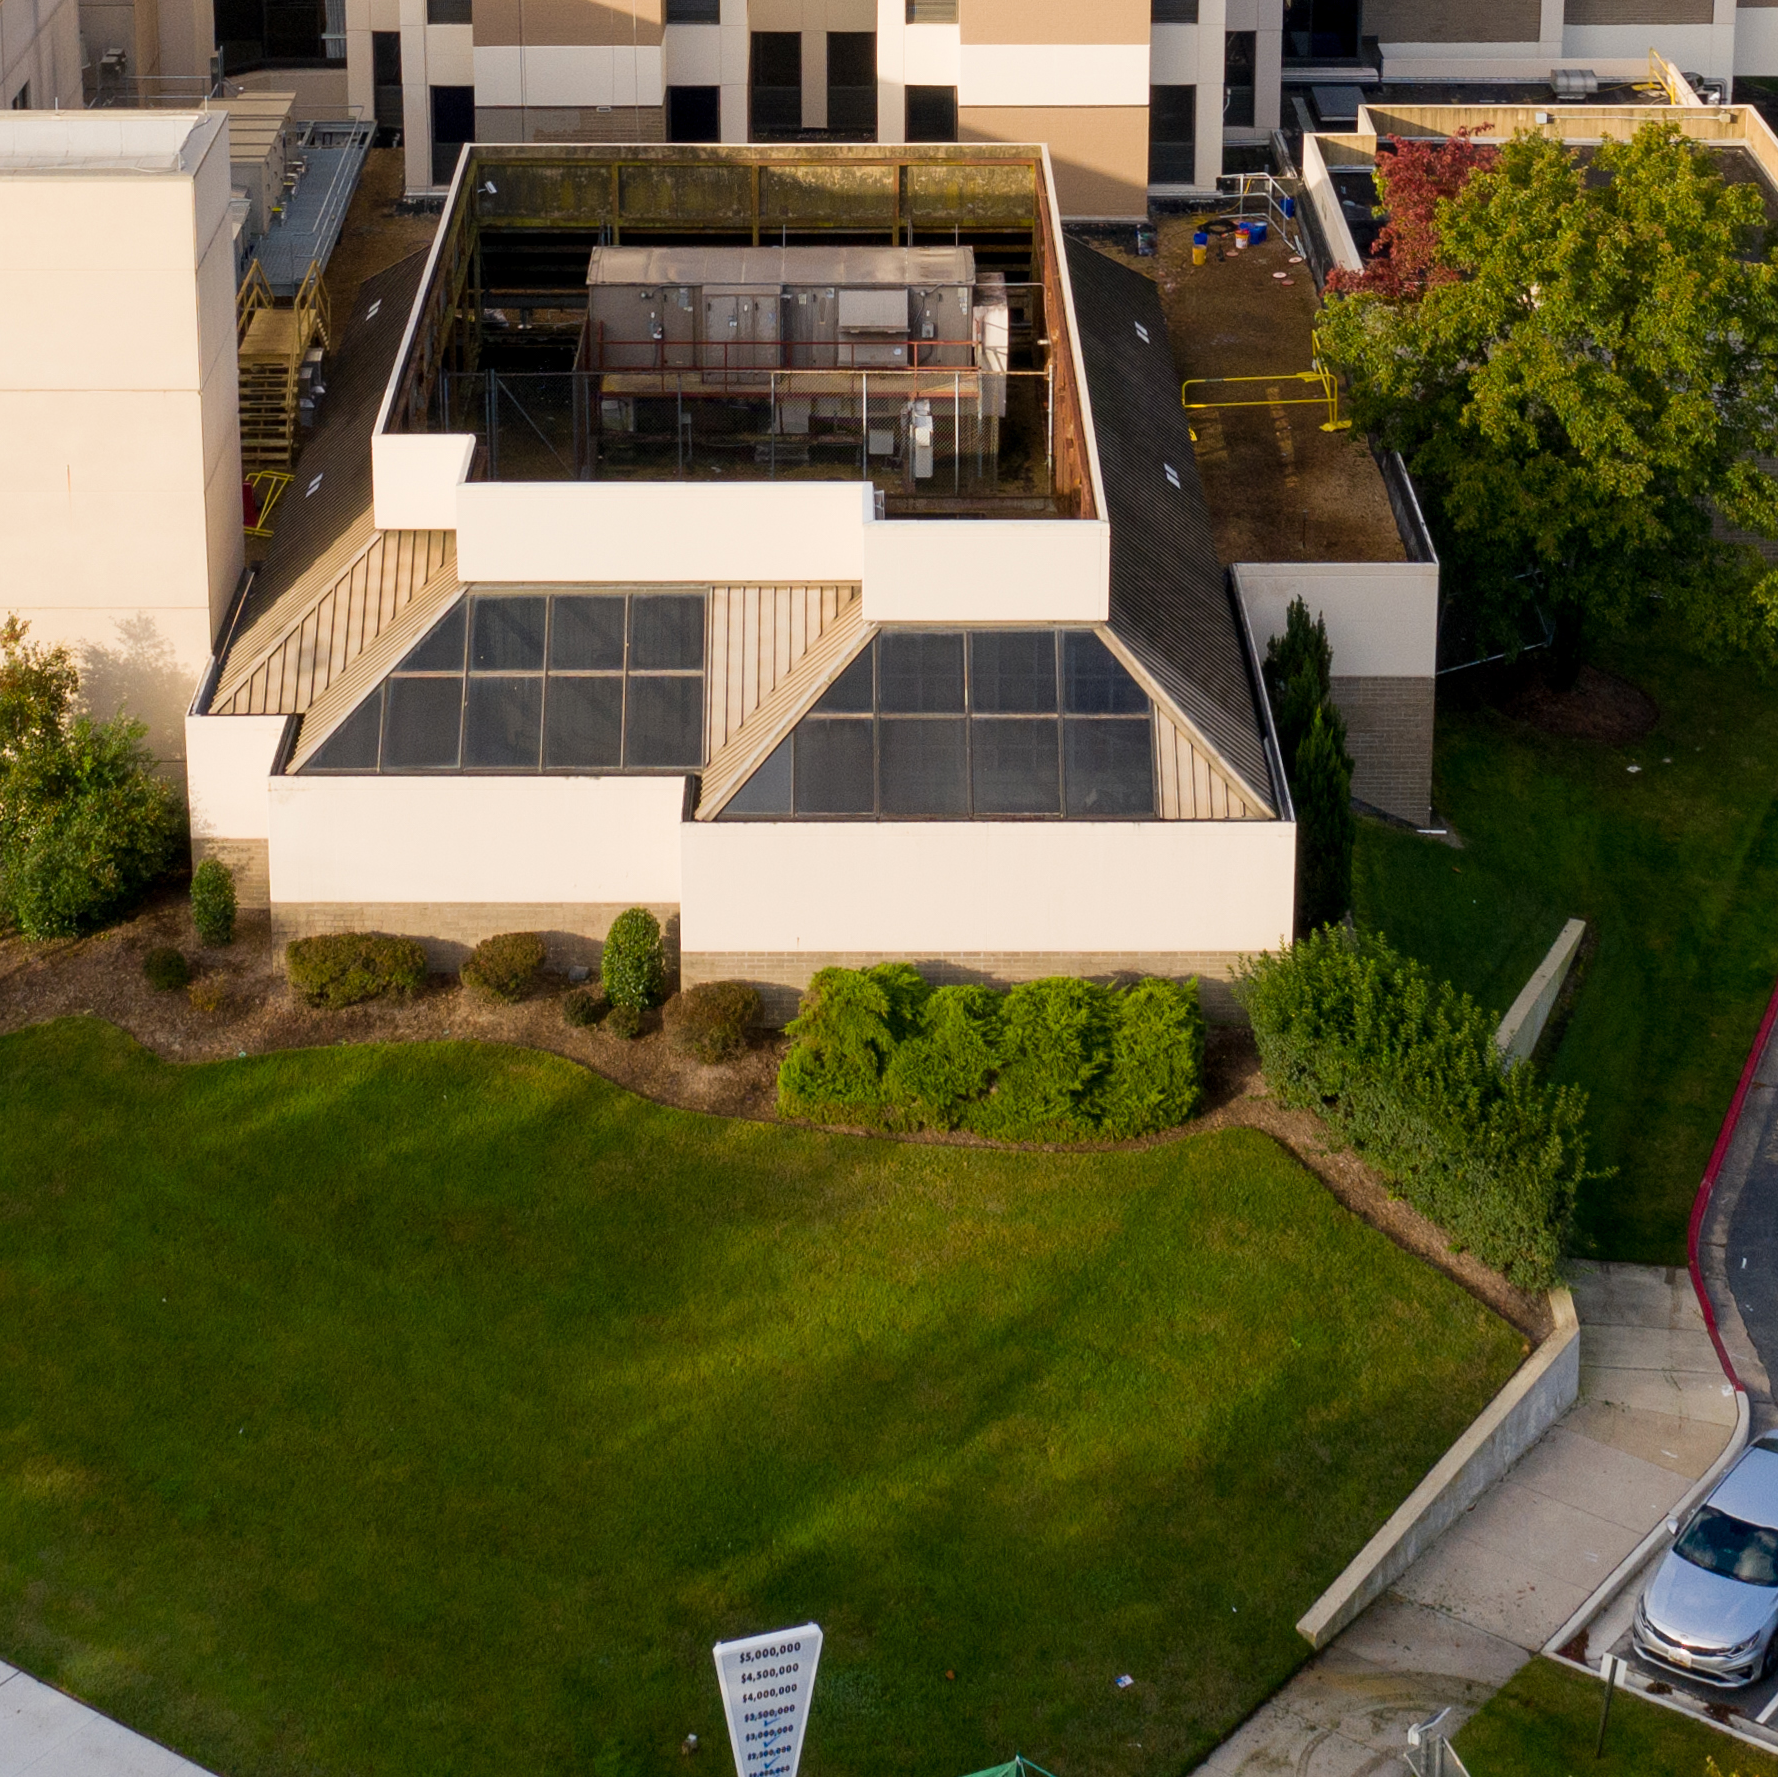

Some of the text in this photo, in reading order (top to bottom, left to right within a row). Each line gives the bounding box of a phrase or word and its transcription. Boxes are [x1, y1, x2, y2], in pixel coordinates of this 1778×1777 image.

[739, 1641, 801, 1664] $5,000,000
[741, 1663, 799, 1684] $4,500,000
[742, 1683, 798, 1704] $4,000,000
[744, 1704, 796, 1723] $3,500,000
[746, 1724, 794, 1742] $3,000,000
